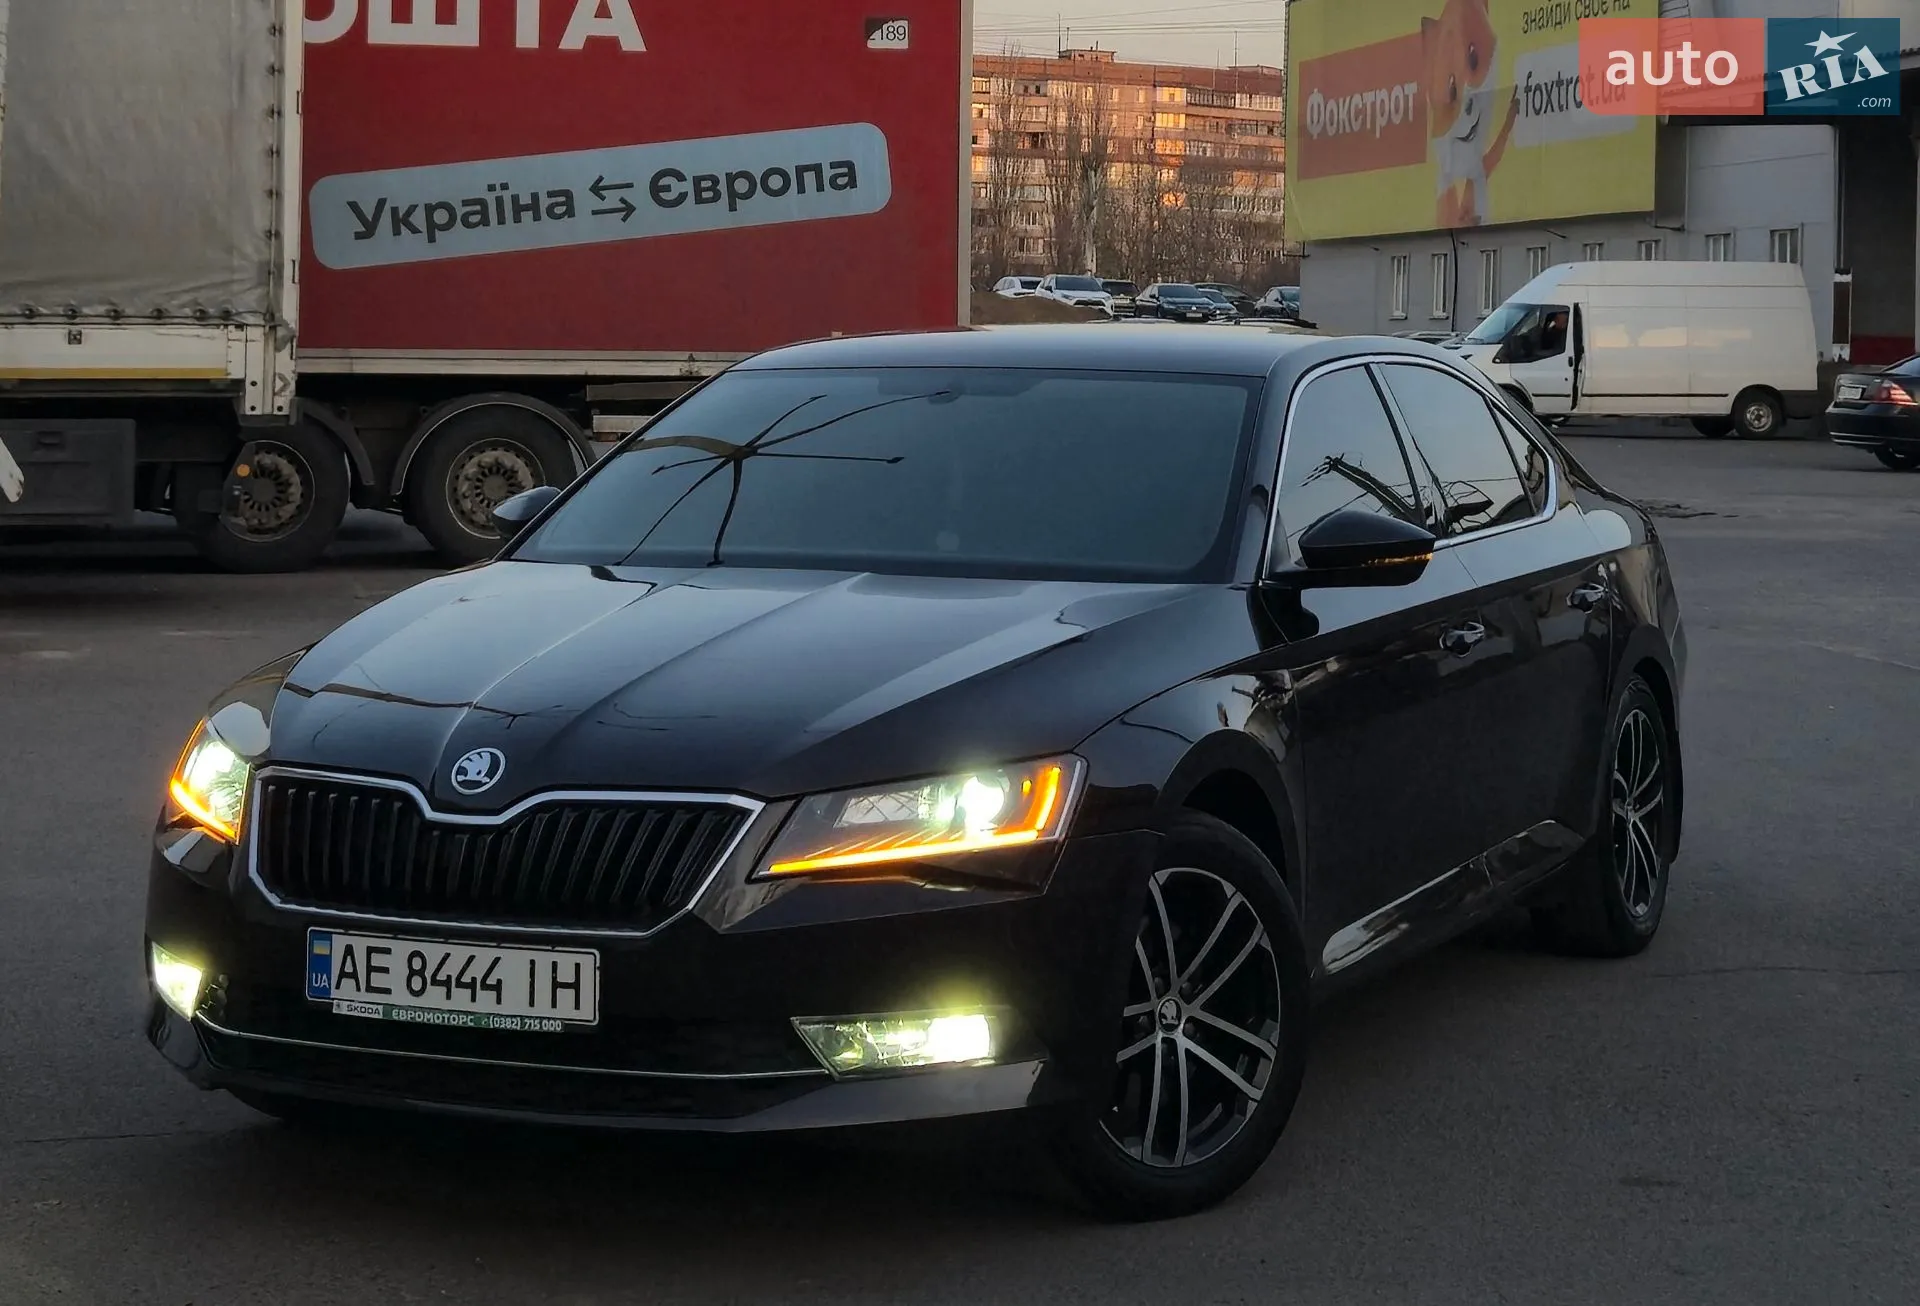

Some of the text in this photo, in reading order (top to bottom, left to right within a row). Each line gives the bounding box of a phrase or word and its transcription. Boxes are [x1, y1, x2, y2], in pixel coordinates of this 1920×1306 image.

[869, 25, 906, 41] 189
[1522, 0, 1571, 34] знайди
[1306, 79, 1418, 140] Фокстрот
[346, 159, 858, 244] Україна Європа
[312, 972, 330, 989] UA
[405, 950, 503, 1006] 8444
